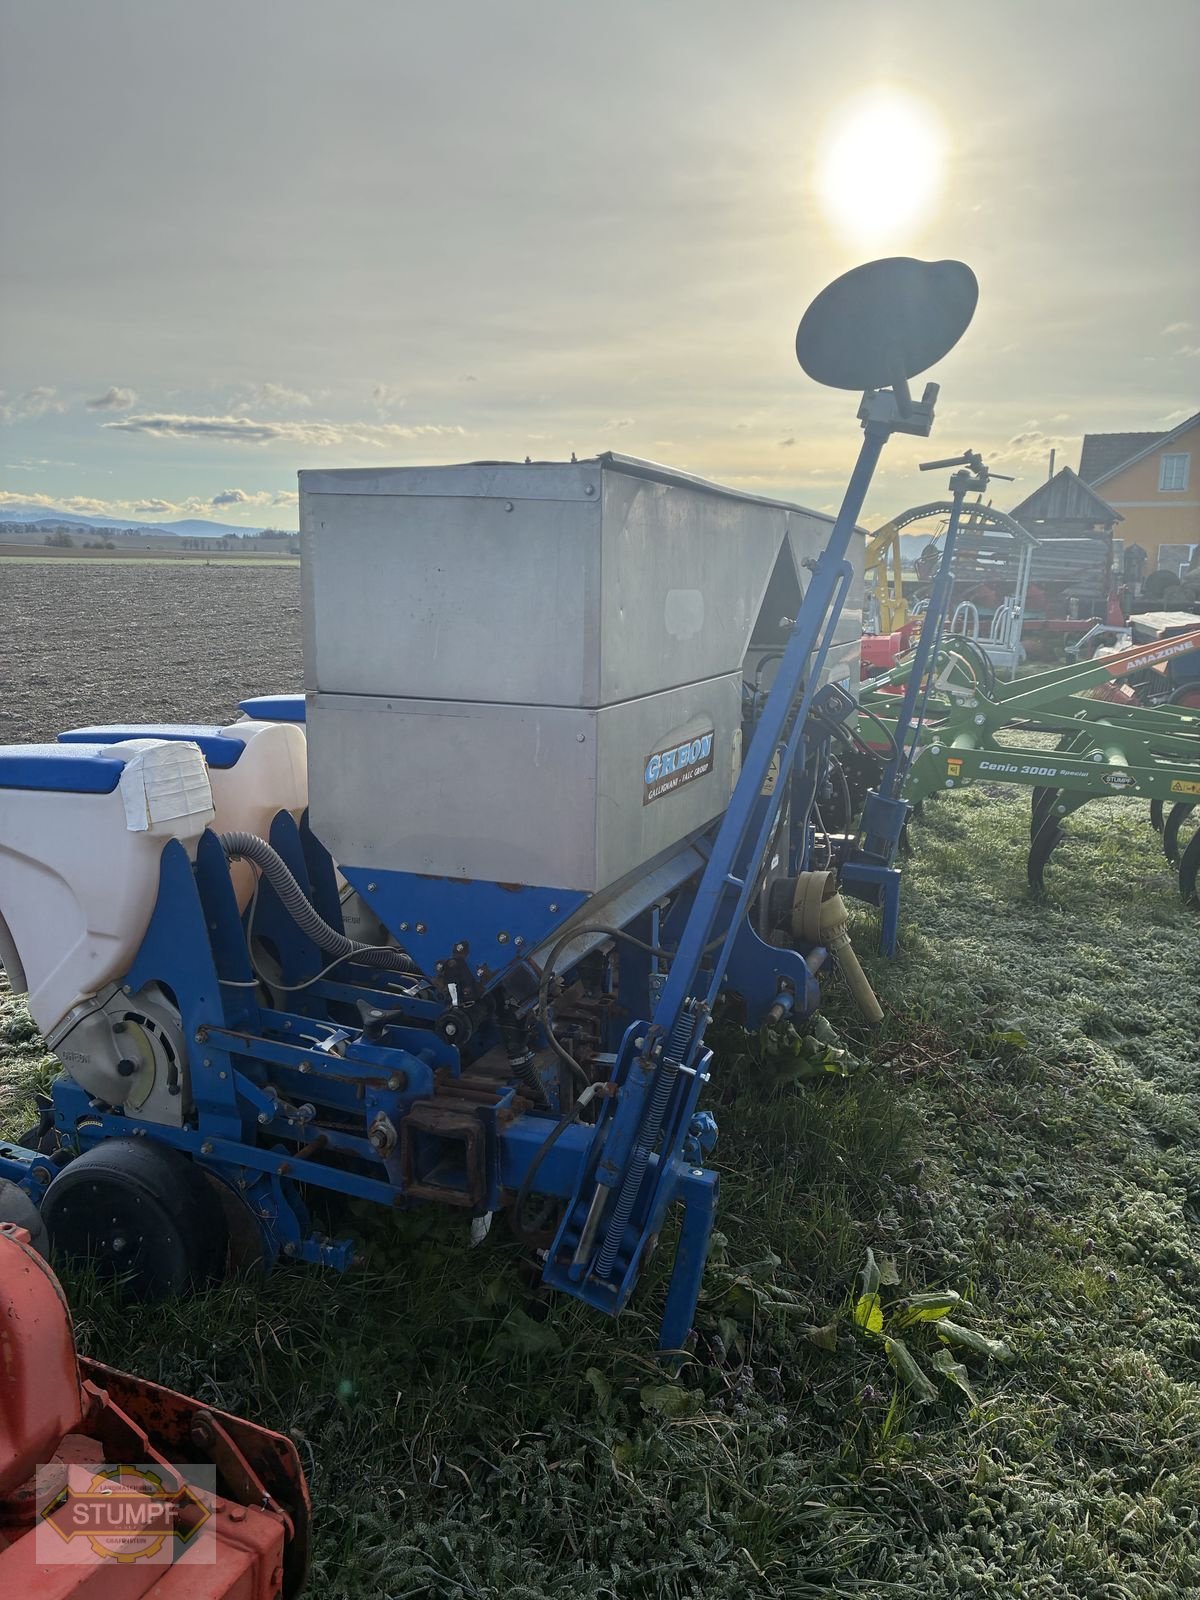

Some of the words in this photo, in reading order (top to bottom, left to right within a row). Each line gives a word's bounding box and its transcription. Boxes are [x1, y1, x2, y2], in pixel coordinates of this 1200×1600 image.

[1127, 641, 1193, 670] AMAZONE
[645, 733, 713, 784] GHEON
[979, 761, 1018, 773] Cenio
[1020, 765, 1056, 777] 3000
[1059, 769, 1089, 777] Special
[648, 778, 679, 800] GALLIGNANI
[694, 763, 709, 776] GROUP
[1106, 775, 1132, 784] STUMPF
